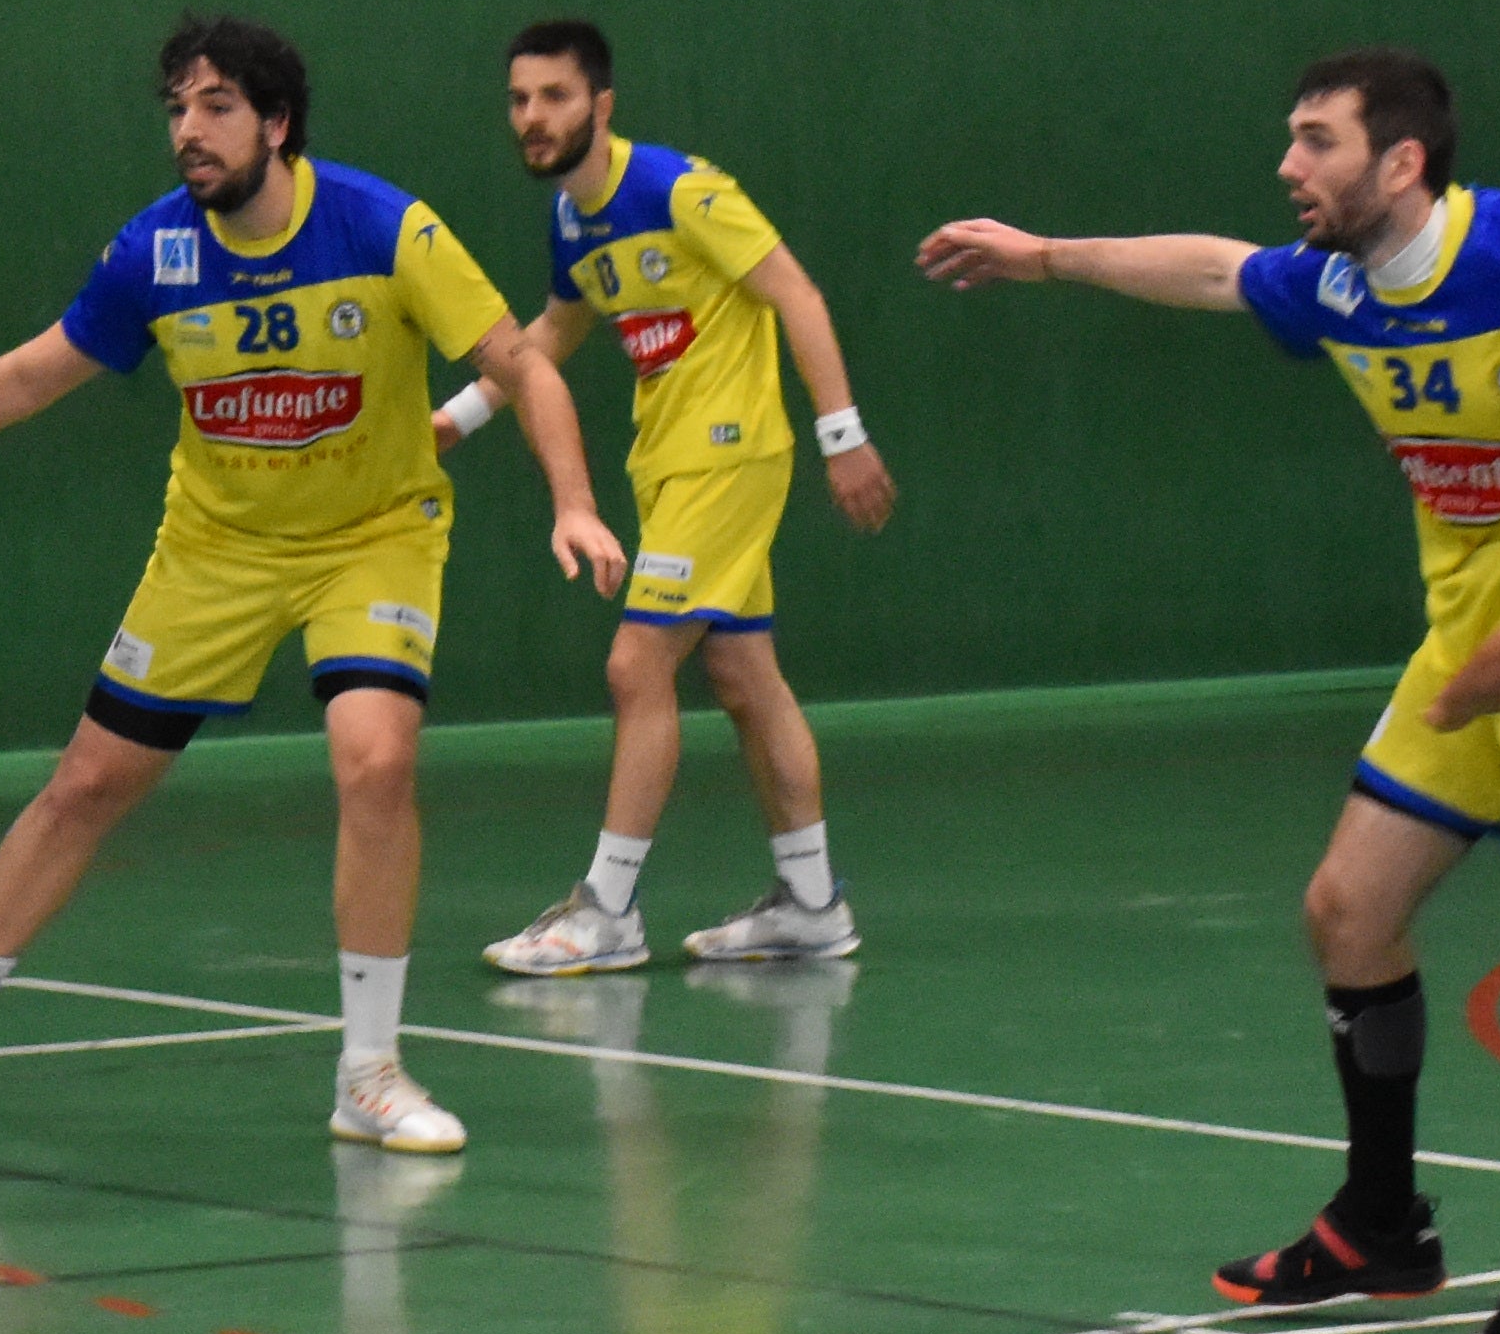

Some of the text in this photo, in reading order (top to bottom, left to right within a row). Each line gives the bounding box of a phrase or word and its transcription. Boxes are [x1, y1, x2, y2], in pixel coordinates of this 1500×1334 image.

[235, 302, 299, 354] 28
[194, 384, 349, 423] Lafuente
[1384, 355, 1461, 414] 34
